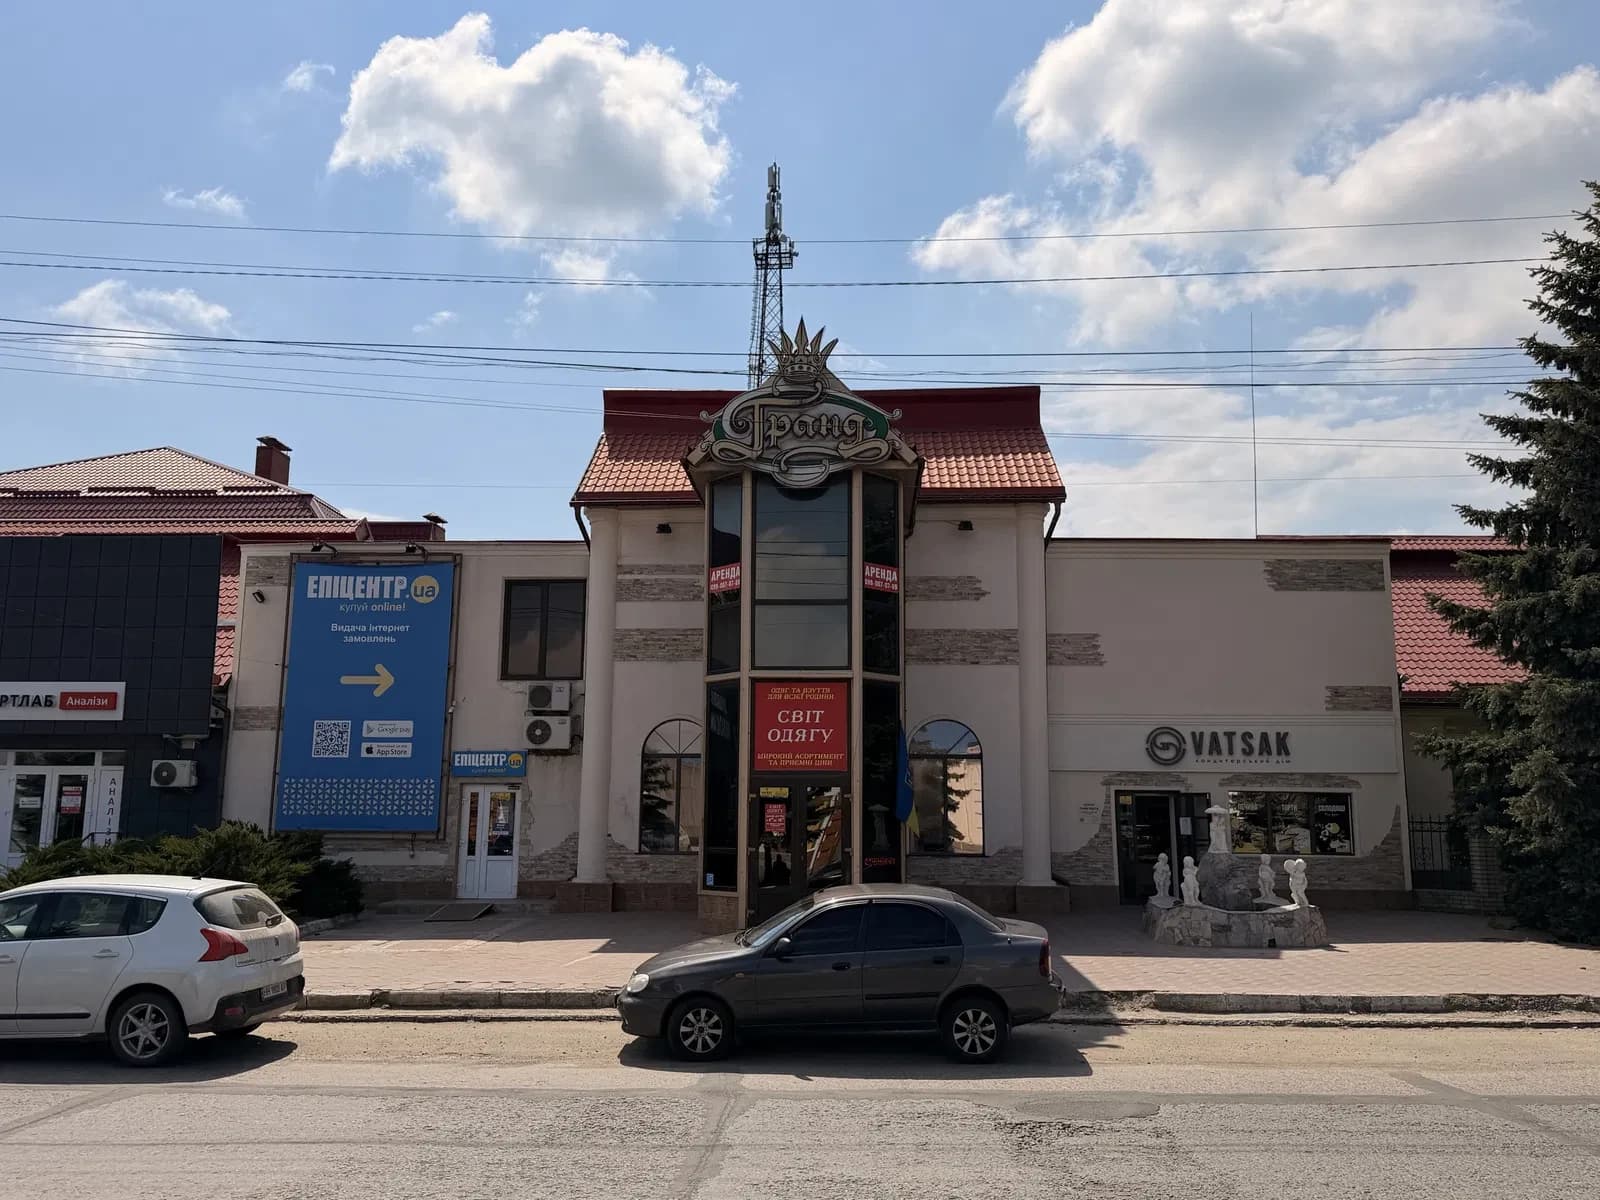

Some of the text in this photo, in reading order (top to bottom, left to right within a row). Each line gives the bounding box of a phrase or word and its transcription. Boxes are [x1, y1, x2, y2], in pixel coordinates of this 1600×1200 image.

[711, 566, 741, 581] АРЕНДА
[864, 565, 898, 582] АРЕНДА
[339, 602, 406, 614] купуй online!
[331, 623, 410, 633] Видача інтернет
[343, 634, 396, 643] замовлень
[67, 696, 108, 706] Аналізи
[777, 710, 824, 723] СВІТ
[378, 725, 399, 734] Google
[767, 728, 834, 743] ОДЯГУ
[1190, 731, 1291, 756] VATSAK
[376, 747, 407, 756] App Store
